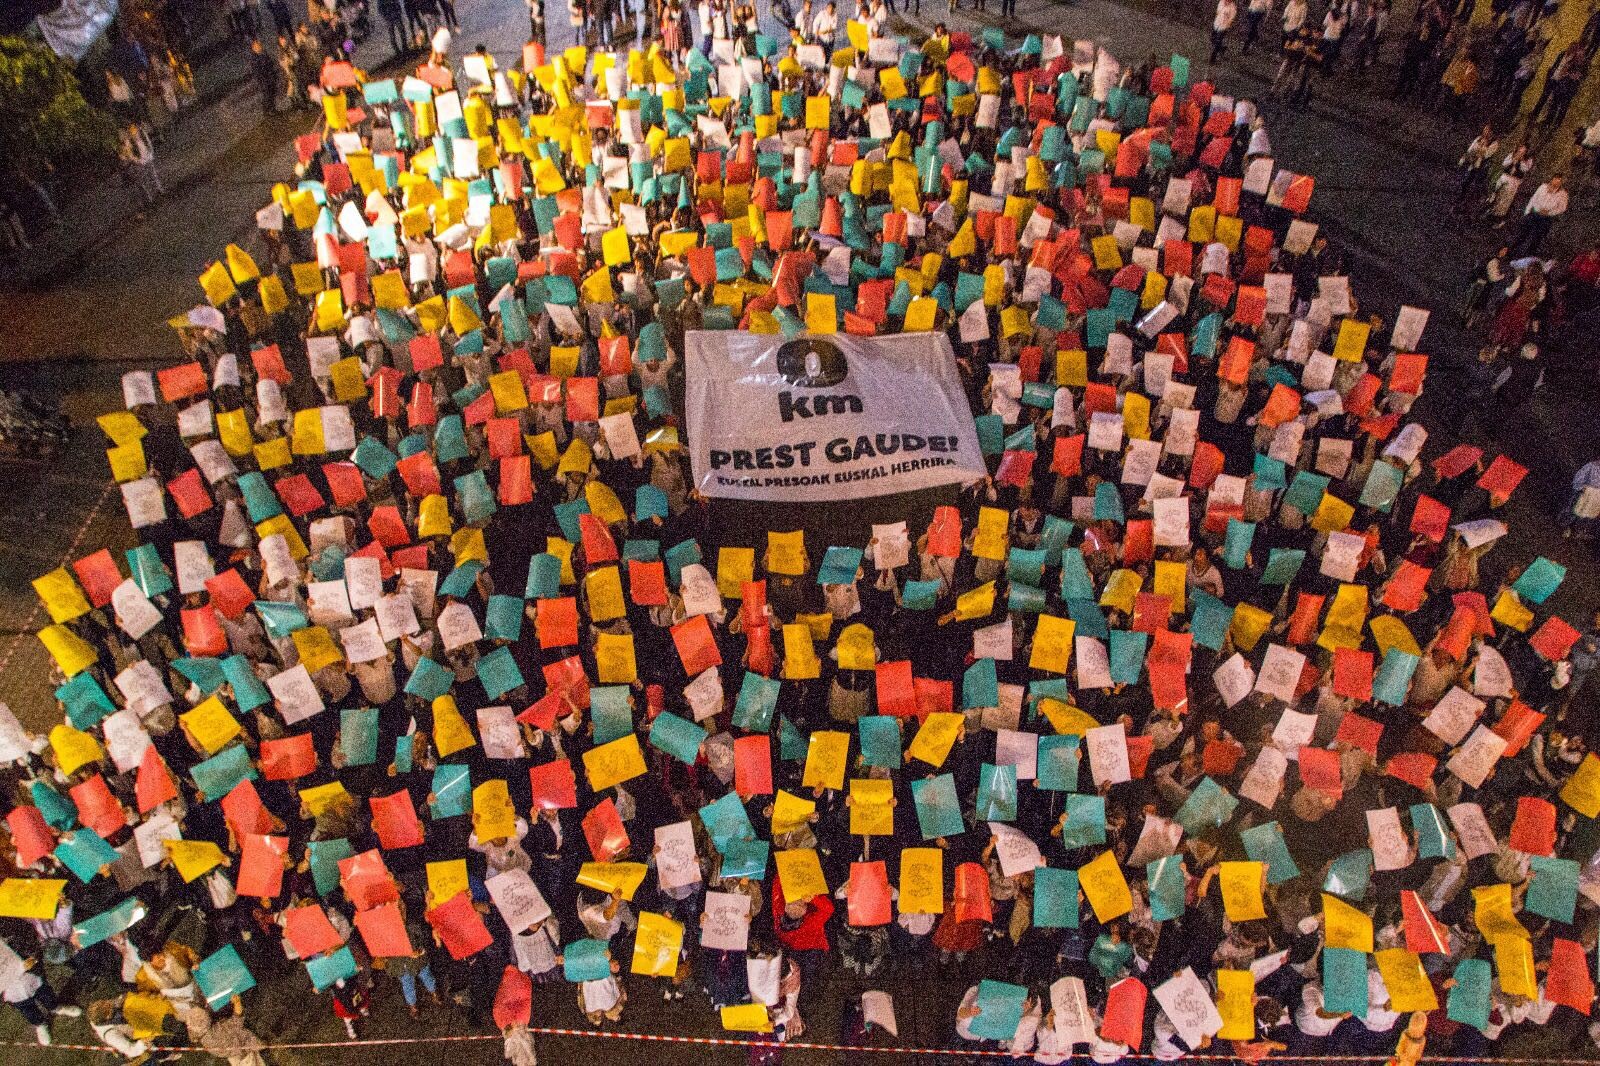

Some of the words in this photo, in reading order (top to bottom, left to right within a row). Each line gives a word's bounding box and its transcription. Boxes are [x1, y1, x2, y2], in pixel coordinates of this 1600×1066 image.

[778, 391, 863, 423] km
[709, 441, 816, 471] PREST
[824, 434, 959, 464] GAUDE!
[764, 474, 832, 487] PRESOAK
[834, 466, 889, 484] EUSKAL
[891, 457, 957, 476] HERRIRA
